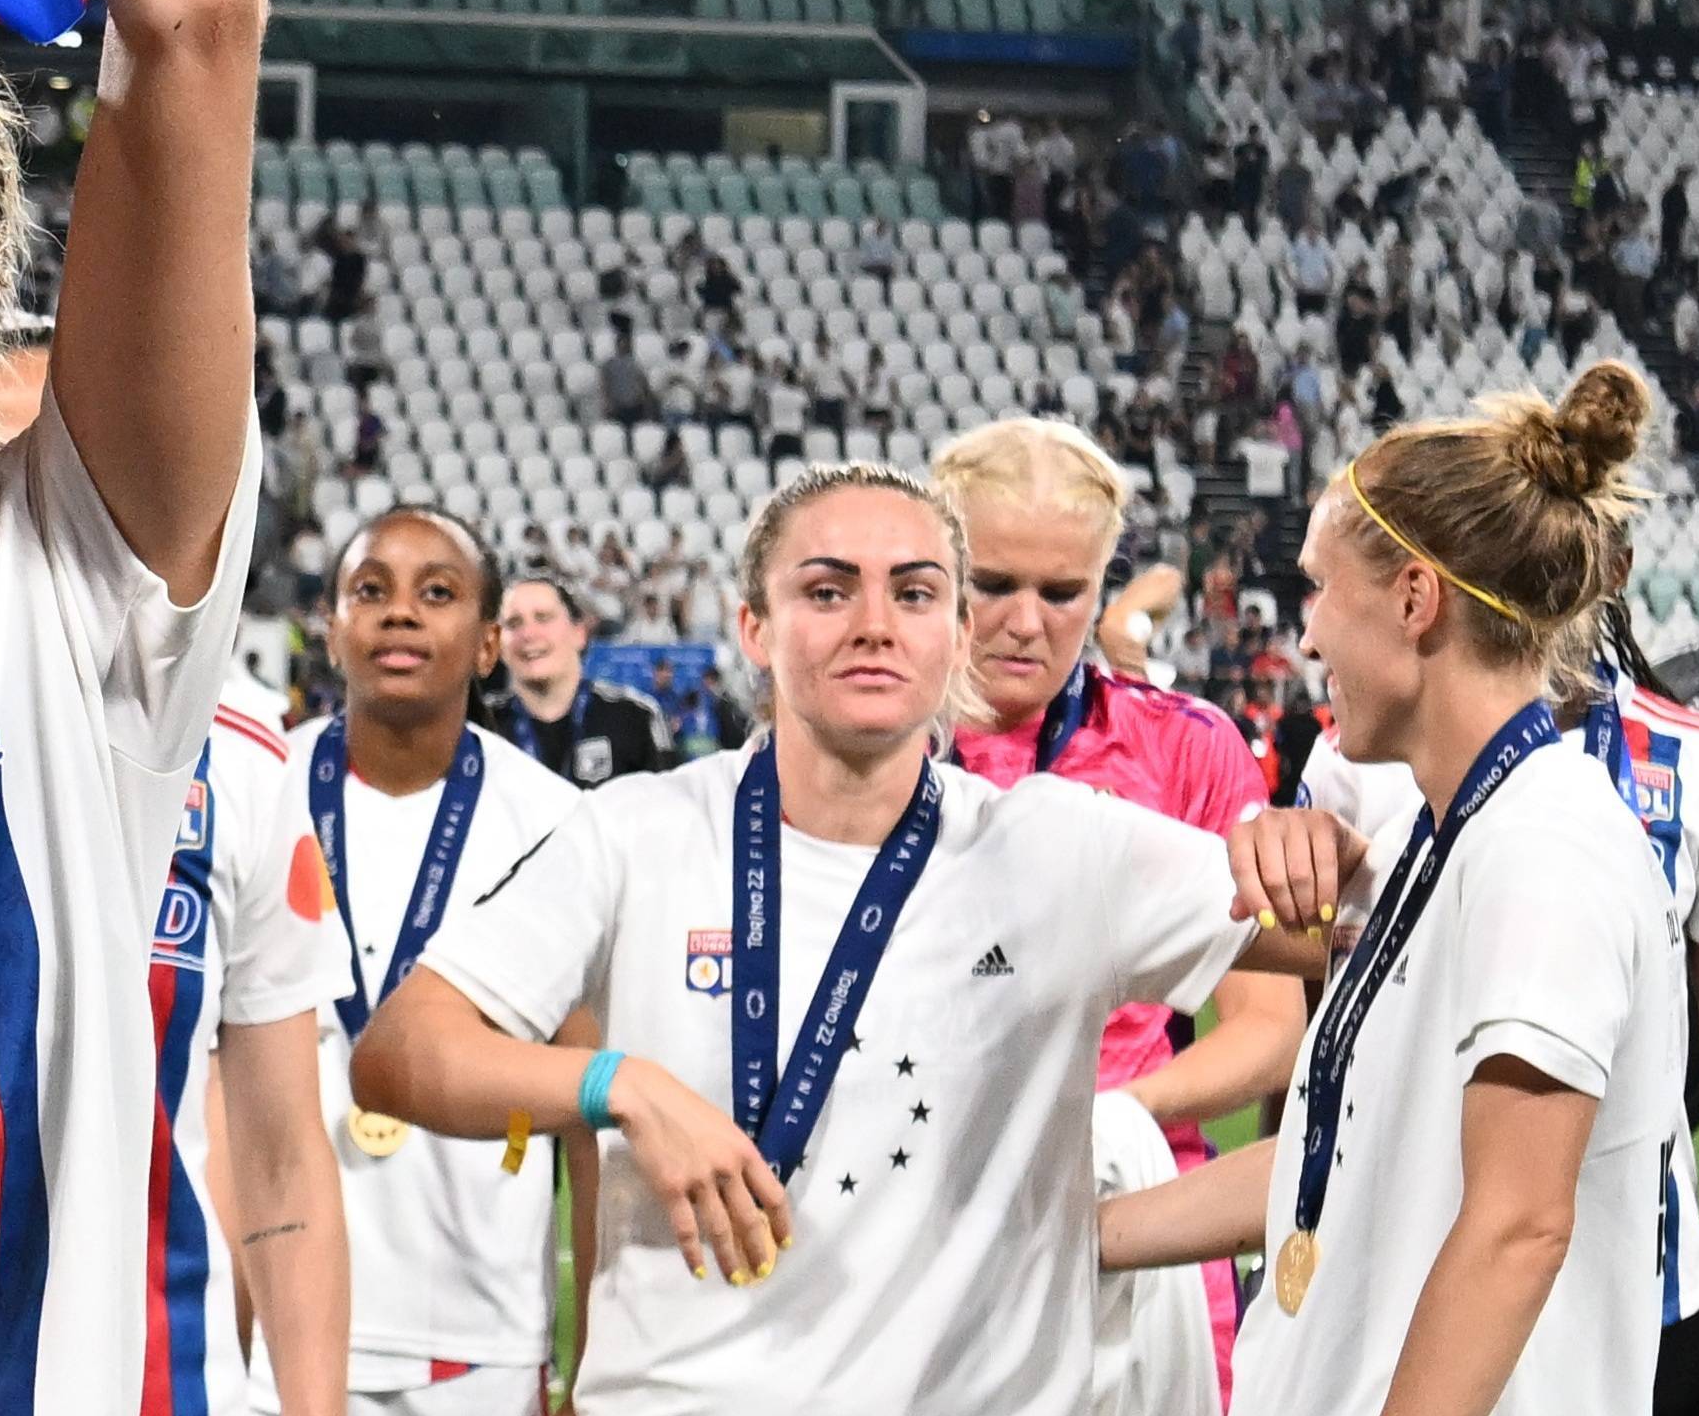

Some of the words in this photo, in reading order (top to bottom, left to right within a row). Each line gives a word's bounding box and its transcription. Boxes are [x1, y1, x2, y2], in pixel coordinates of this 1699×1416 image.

[1497, 743, 1520, 769] 22
[749, 786, 765, 861] FINAL
[888, 807, 931, 874] FINAL
[747, 867, 766, 891] 22
[970, 963, 1016, 976] adidas
[814, 1020, 838, 1047] 22
[784, 1052, 824, 1125] FINAL
